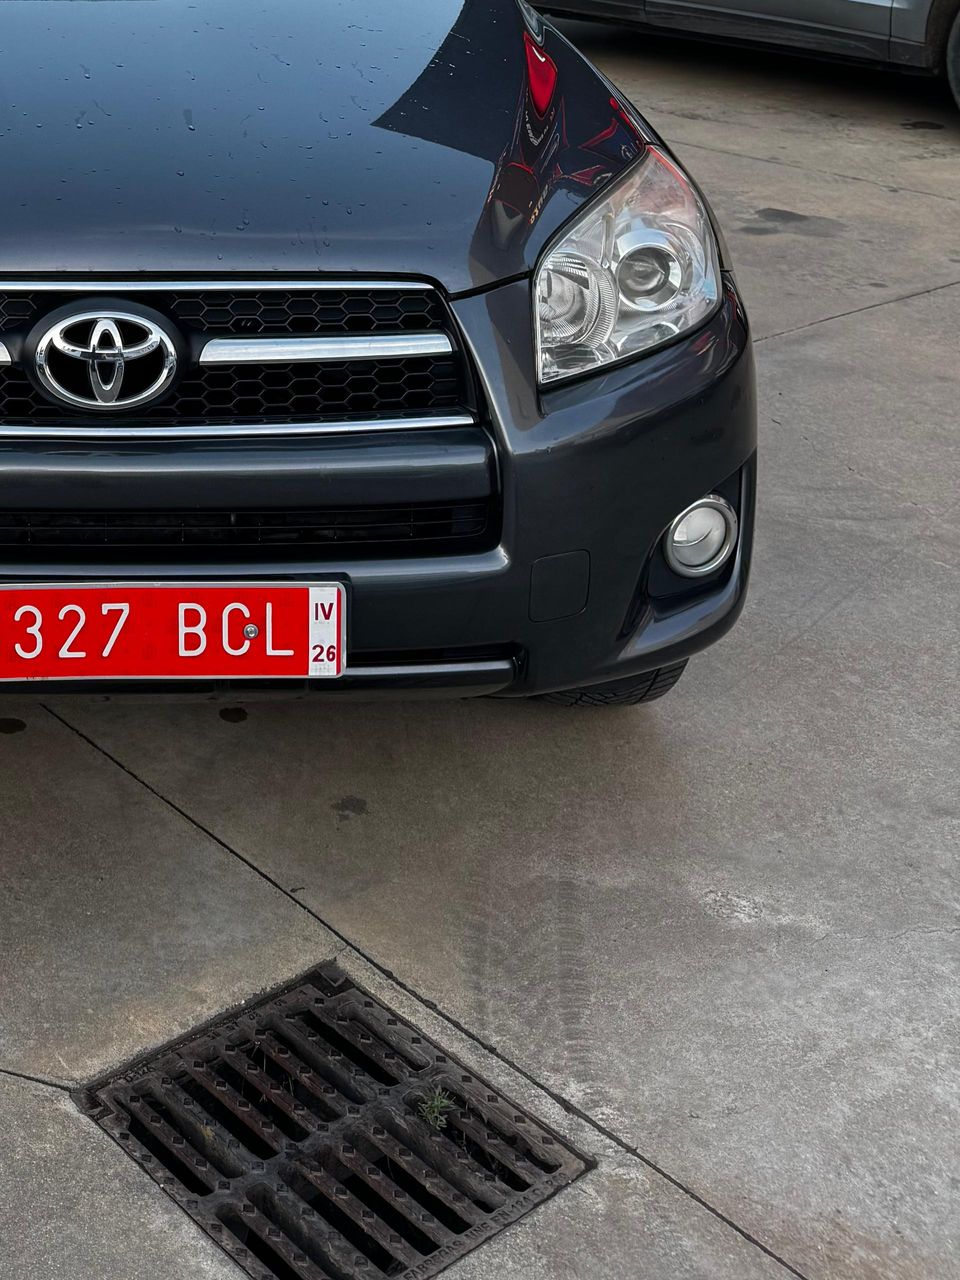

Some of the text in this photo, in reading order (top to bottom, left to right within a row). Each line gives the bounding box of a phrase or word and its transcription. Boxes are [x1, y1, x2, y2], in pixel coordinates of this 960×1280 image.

[314, 603, 334, 621] IV
[178, 602, 295, 657] BCL
[312, 644, 336, 662] 26
